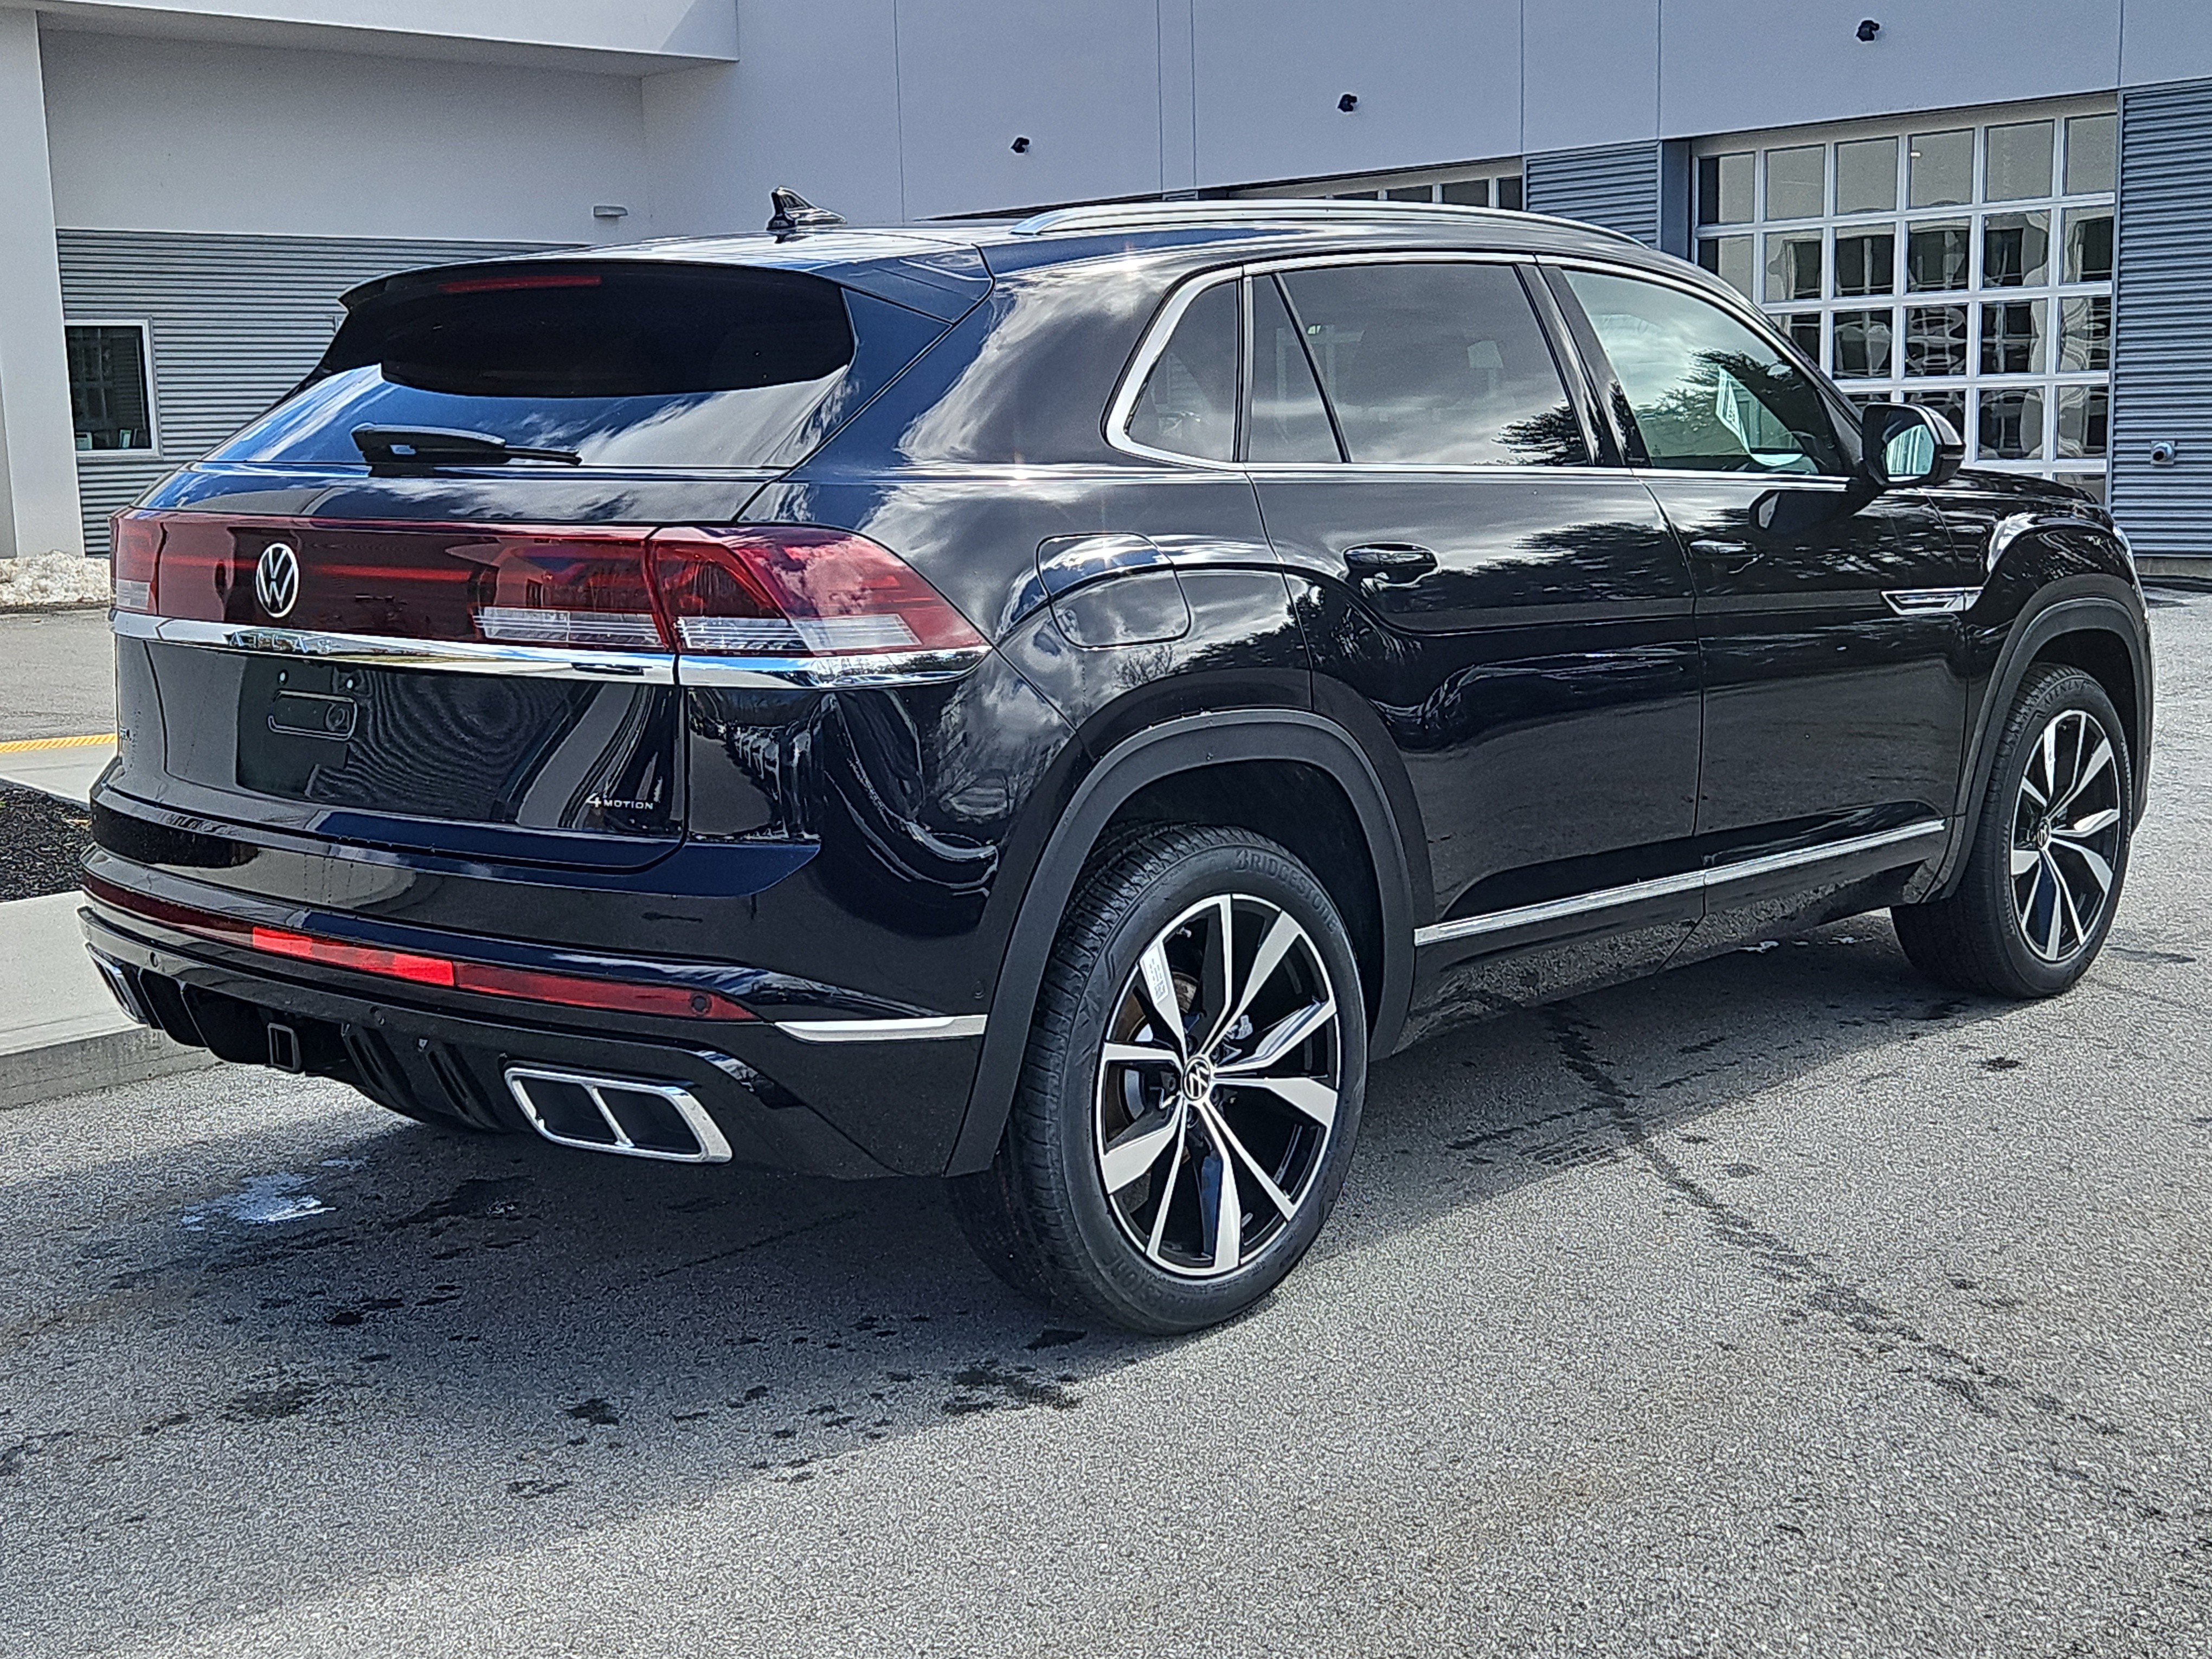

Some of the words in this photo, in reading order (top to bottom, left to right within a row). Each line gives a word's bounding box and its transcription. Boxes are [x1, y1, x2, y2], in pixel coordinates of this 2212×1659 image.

[256, 544, 298, 617] VW
[585, 792, 654, 810] 4MOTION
[1233, 848, 1339, 934] BRIDGESTONE
